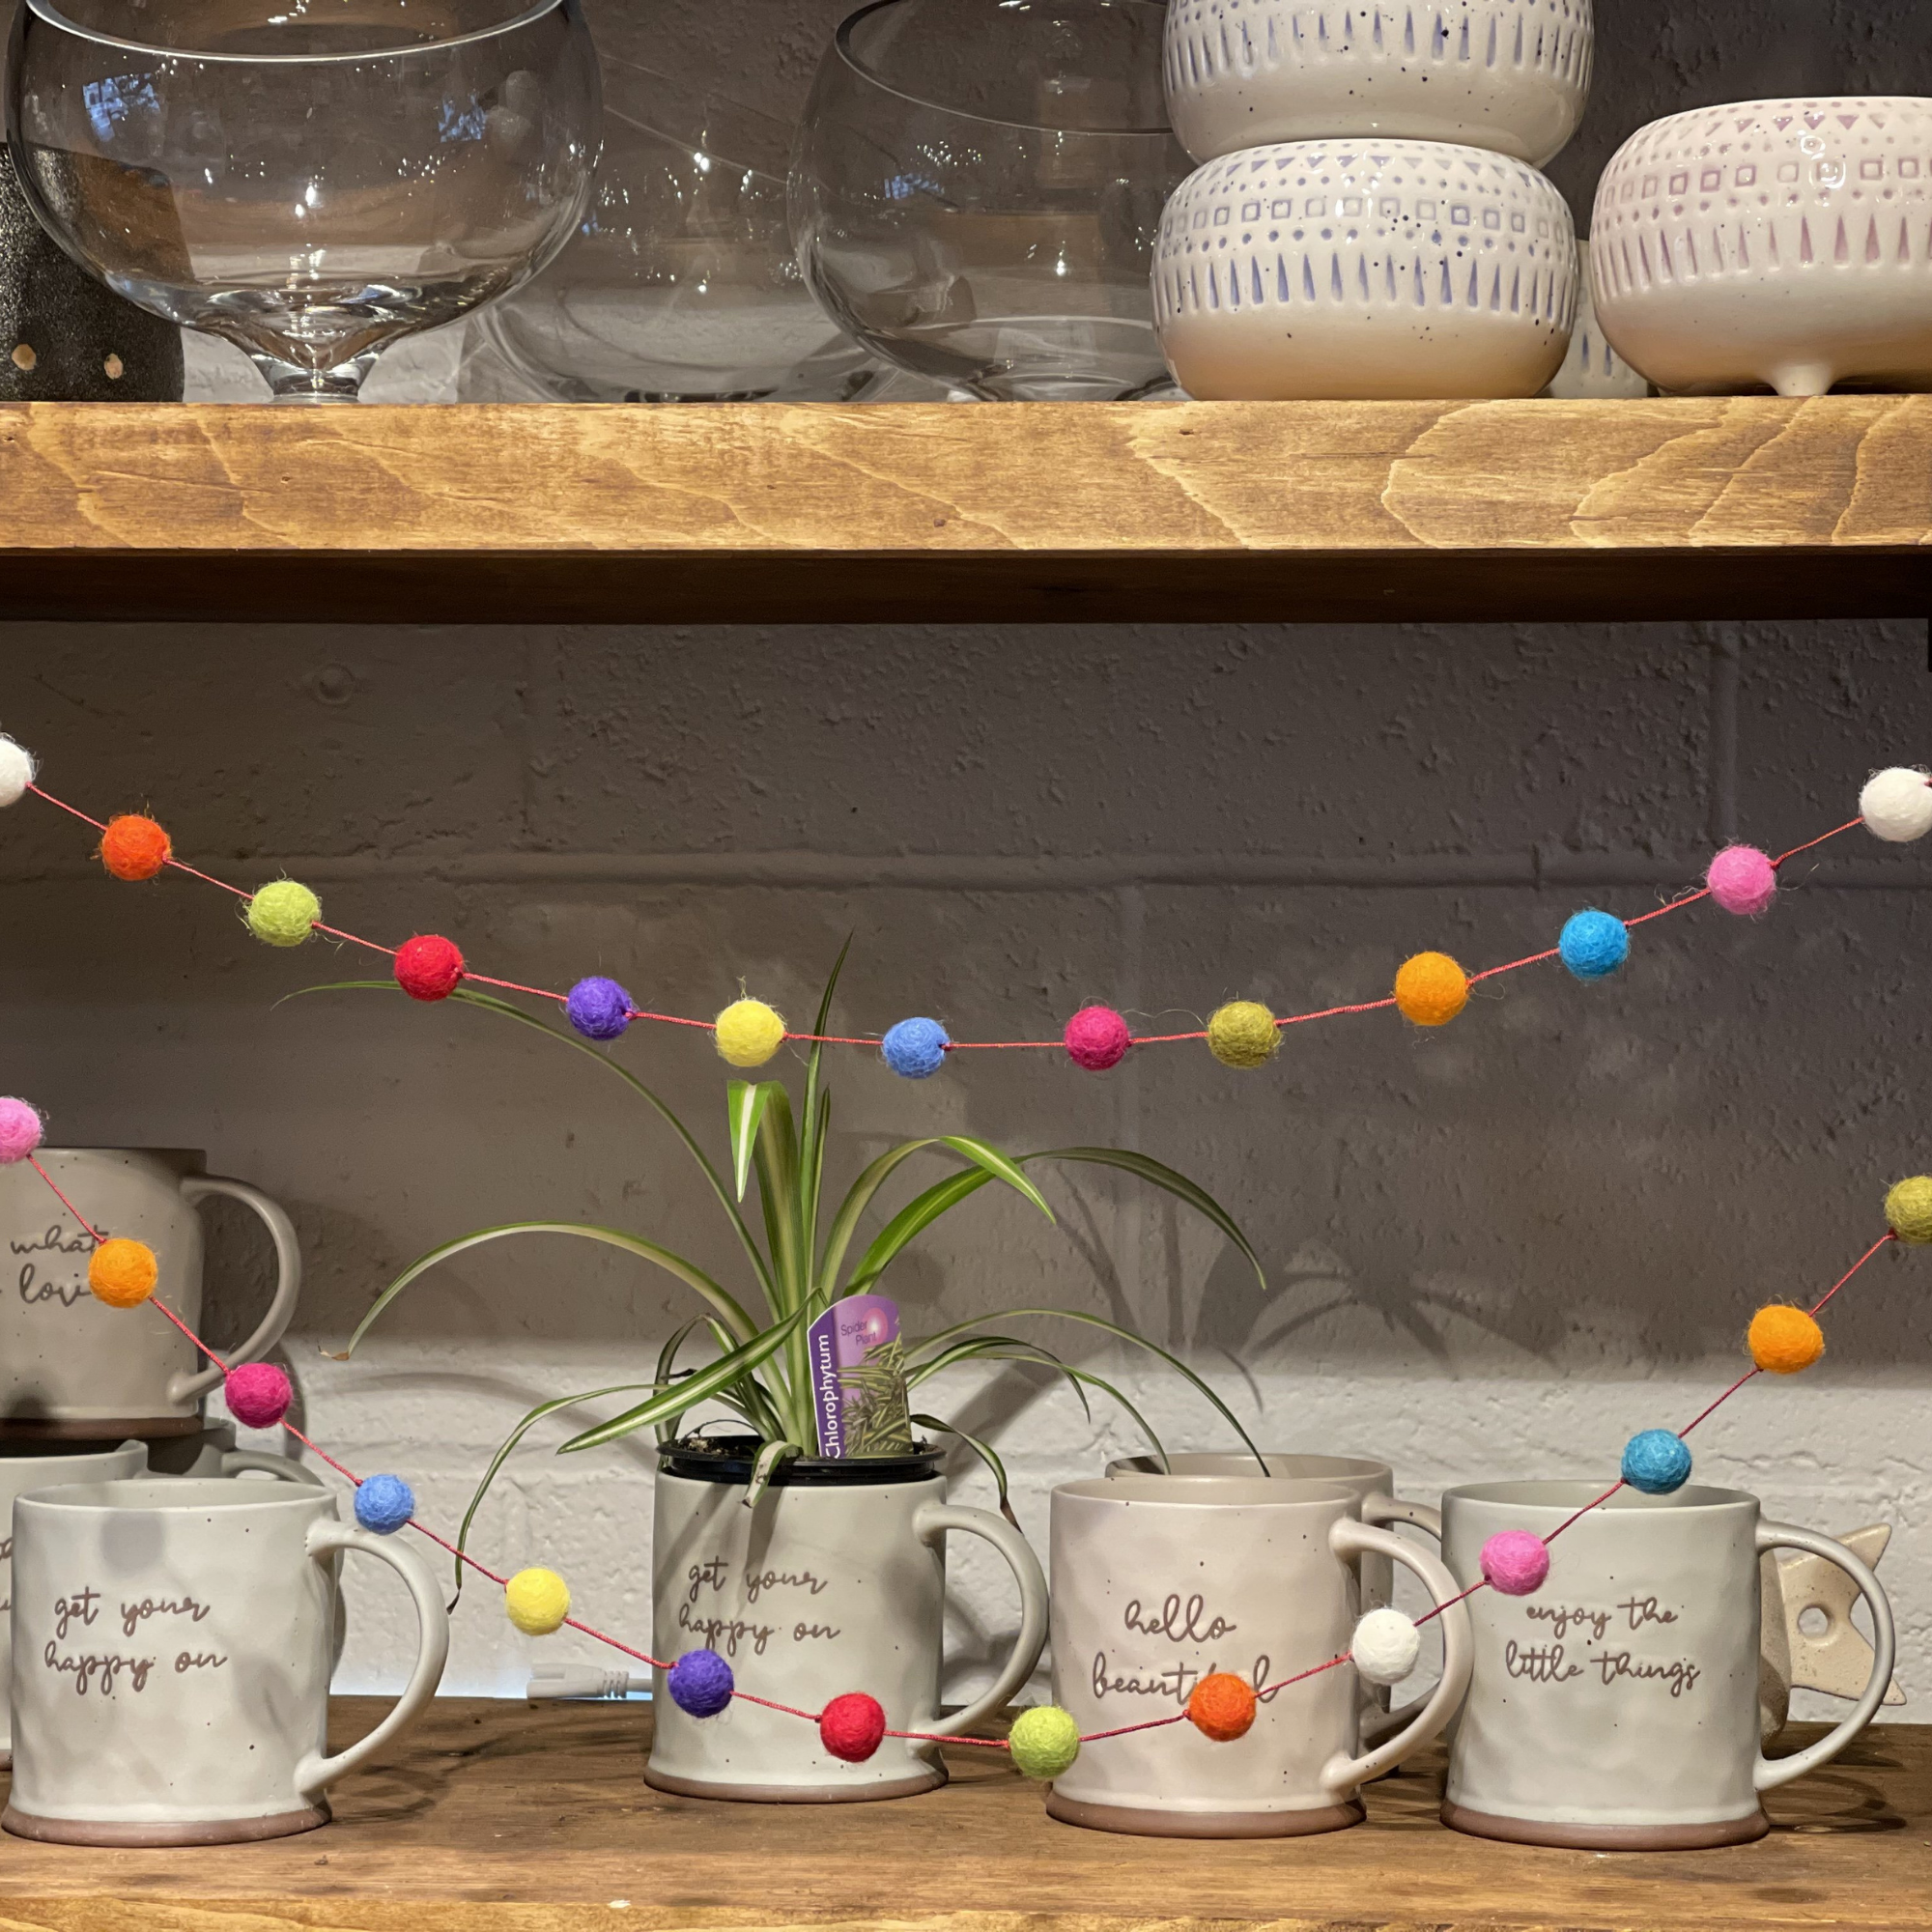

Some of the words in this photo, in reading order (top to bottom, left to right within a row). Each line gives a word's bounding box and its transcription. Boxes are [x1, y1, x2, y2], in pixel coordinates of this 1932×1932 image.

[10, 1224, 109, 1255] what
[19, 1263, 93, 1307] lov
[840, 1320, 868, 1337] Spider
[855, 1331, 877, 1347] Plant
[817, 1334, 840, 1460] Chlorophytum
[689, 1555, 728, 1603] get
[746, 1571, 828, 1604] your
[54, 1585, 101, 1640] get
[121, 1597, 211, 1637] your
[678, 1603, 775, 1657] happy
[793, 1622, 841, 1642] on
[1123, 1593, 1237, 1643] hello
[1526, 1605, 1612, 1640] enjoy
[1616, 1596, 1679, 1631] the
[44, 1639, 155, 1696] happy
[174, 1651, 228, 1674] on
[1092, 1651, 1281, 1706] beautl
[1505, 1639, 1585, 1683] little
[1589, 1650, 1701, 1698] things
